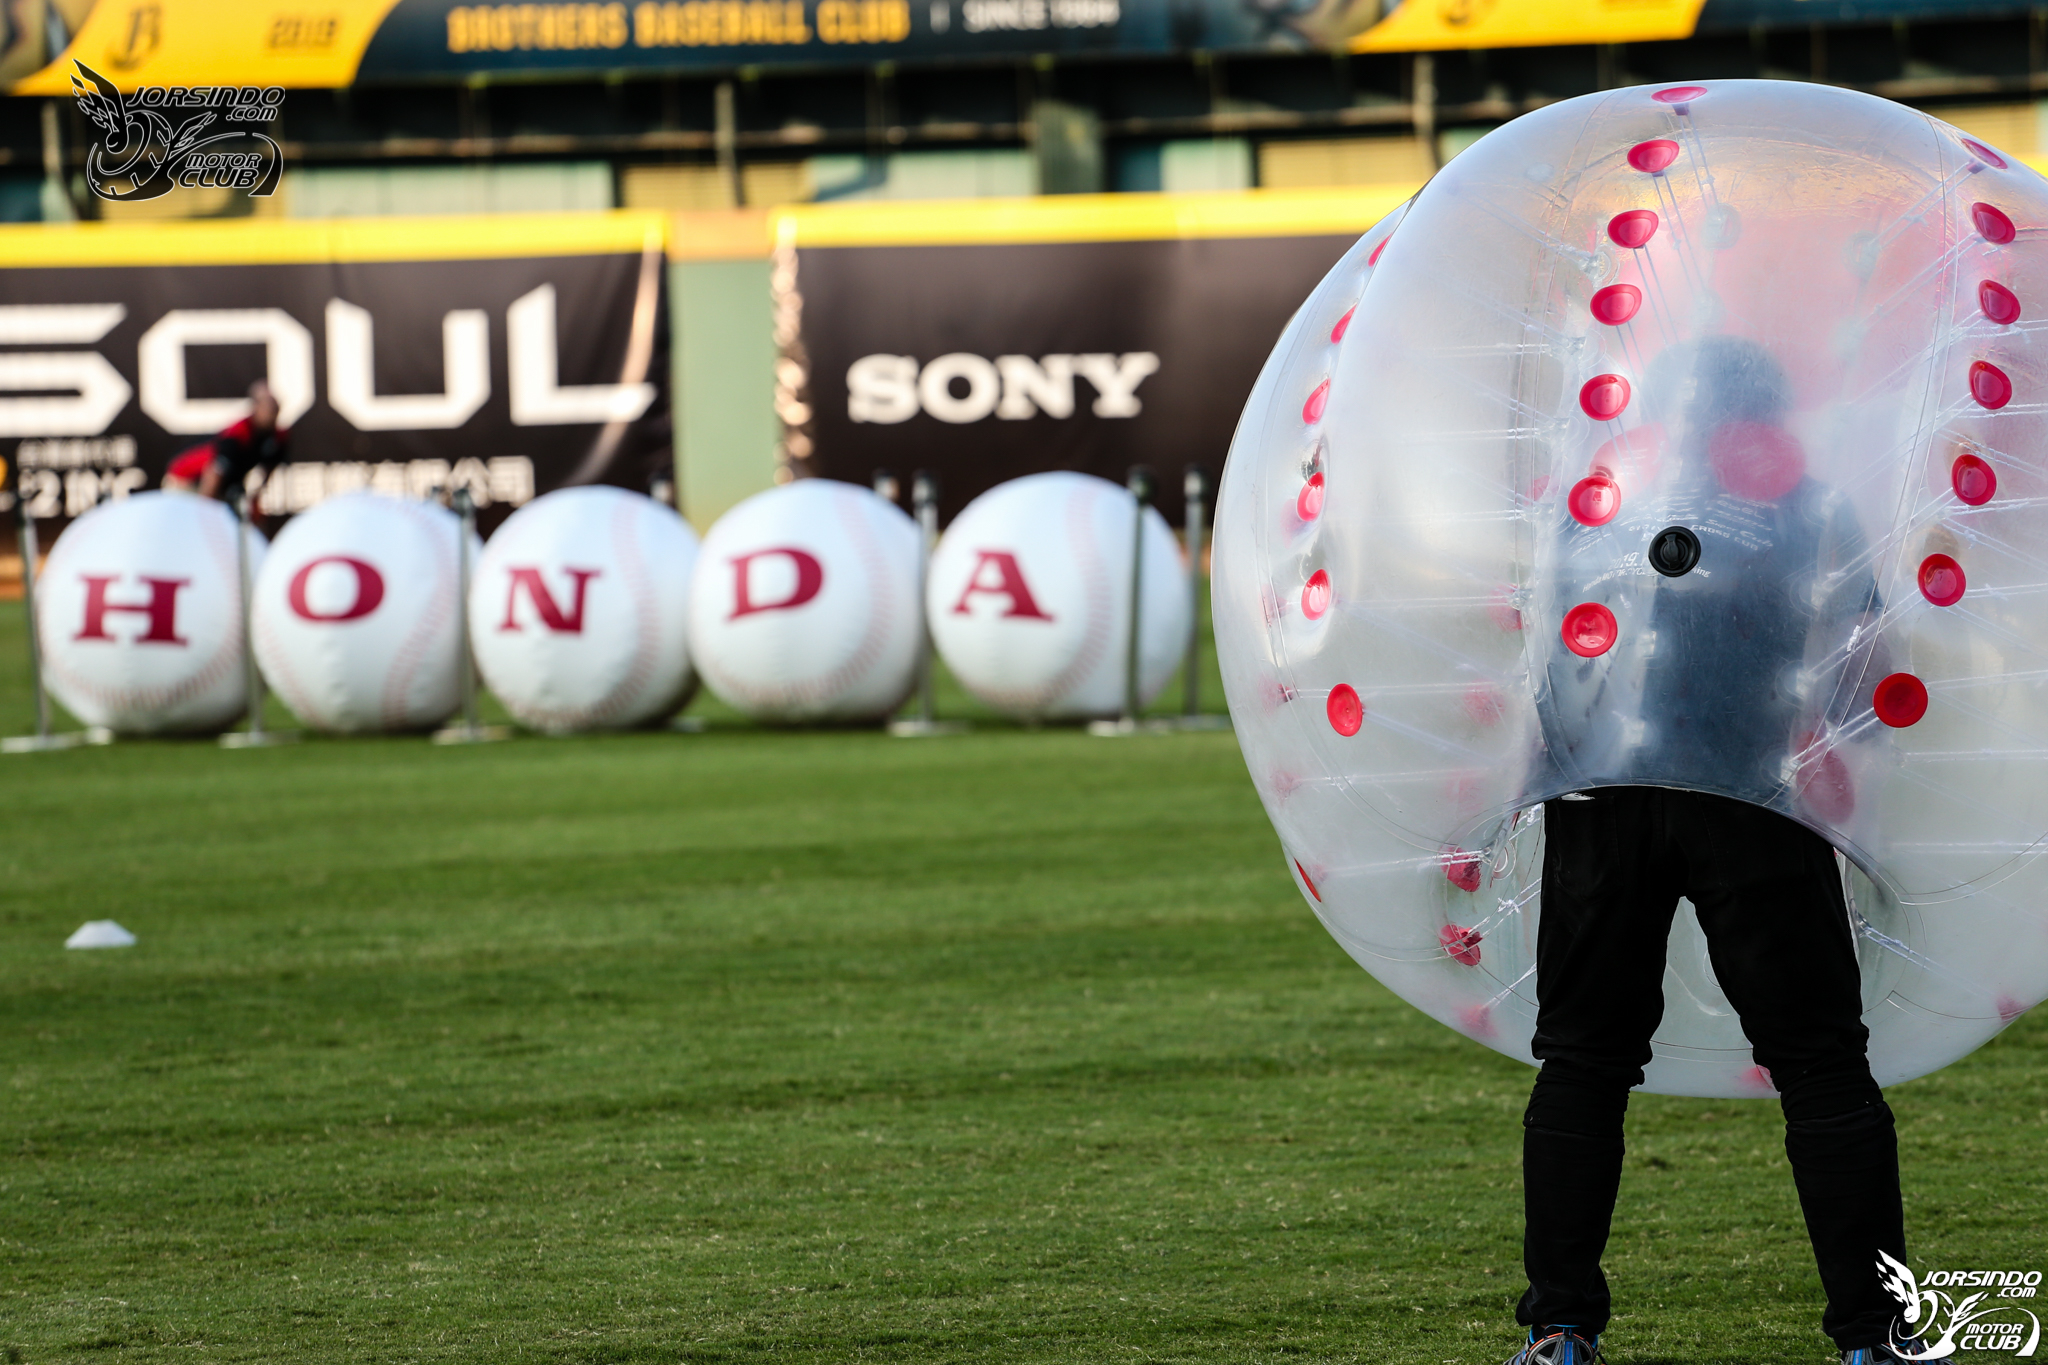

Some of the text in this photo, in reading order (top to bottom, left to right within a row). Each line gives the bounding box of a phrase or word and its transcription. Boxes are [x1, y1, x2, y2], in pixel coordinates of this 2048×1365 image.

[447, 4, 626, 53] BROTHERS
[634, 0, 811, 47] BASEBALL
[816, 0, 911, 43] CLUB
[846, 351, 1159, 424] SONY
